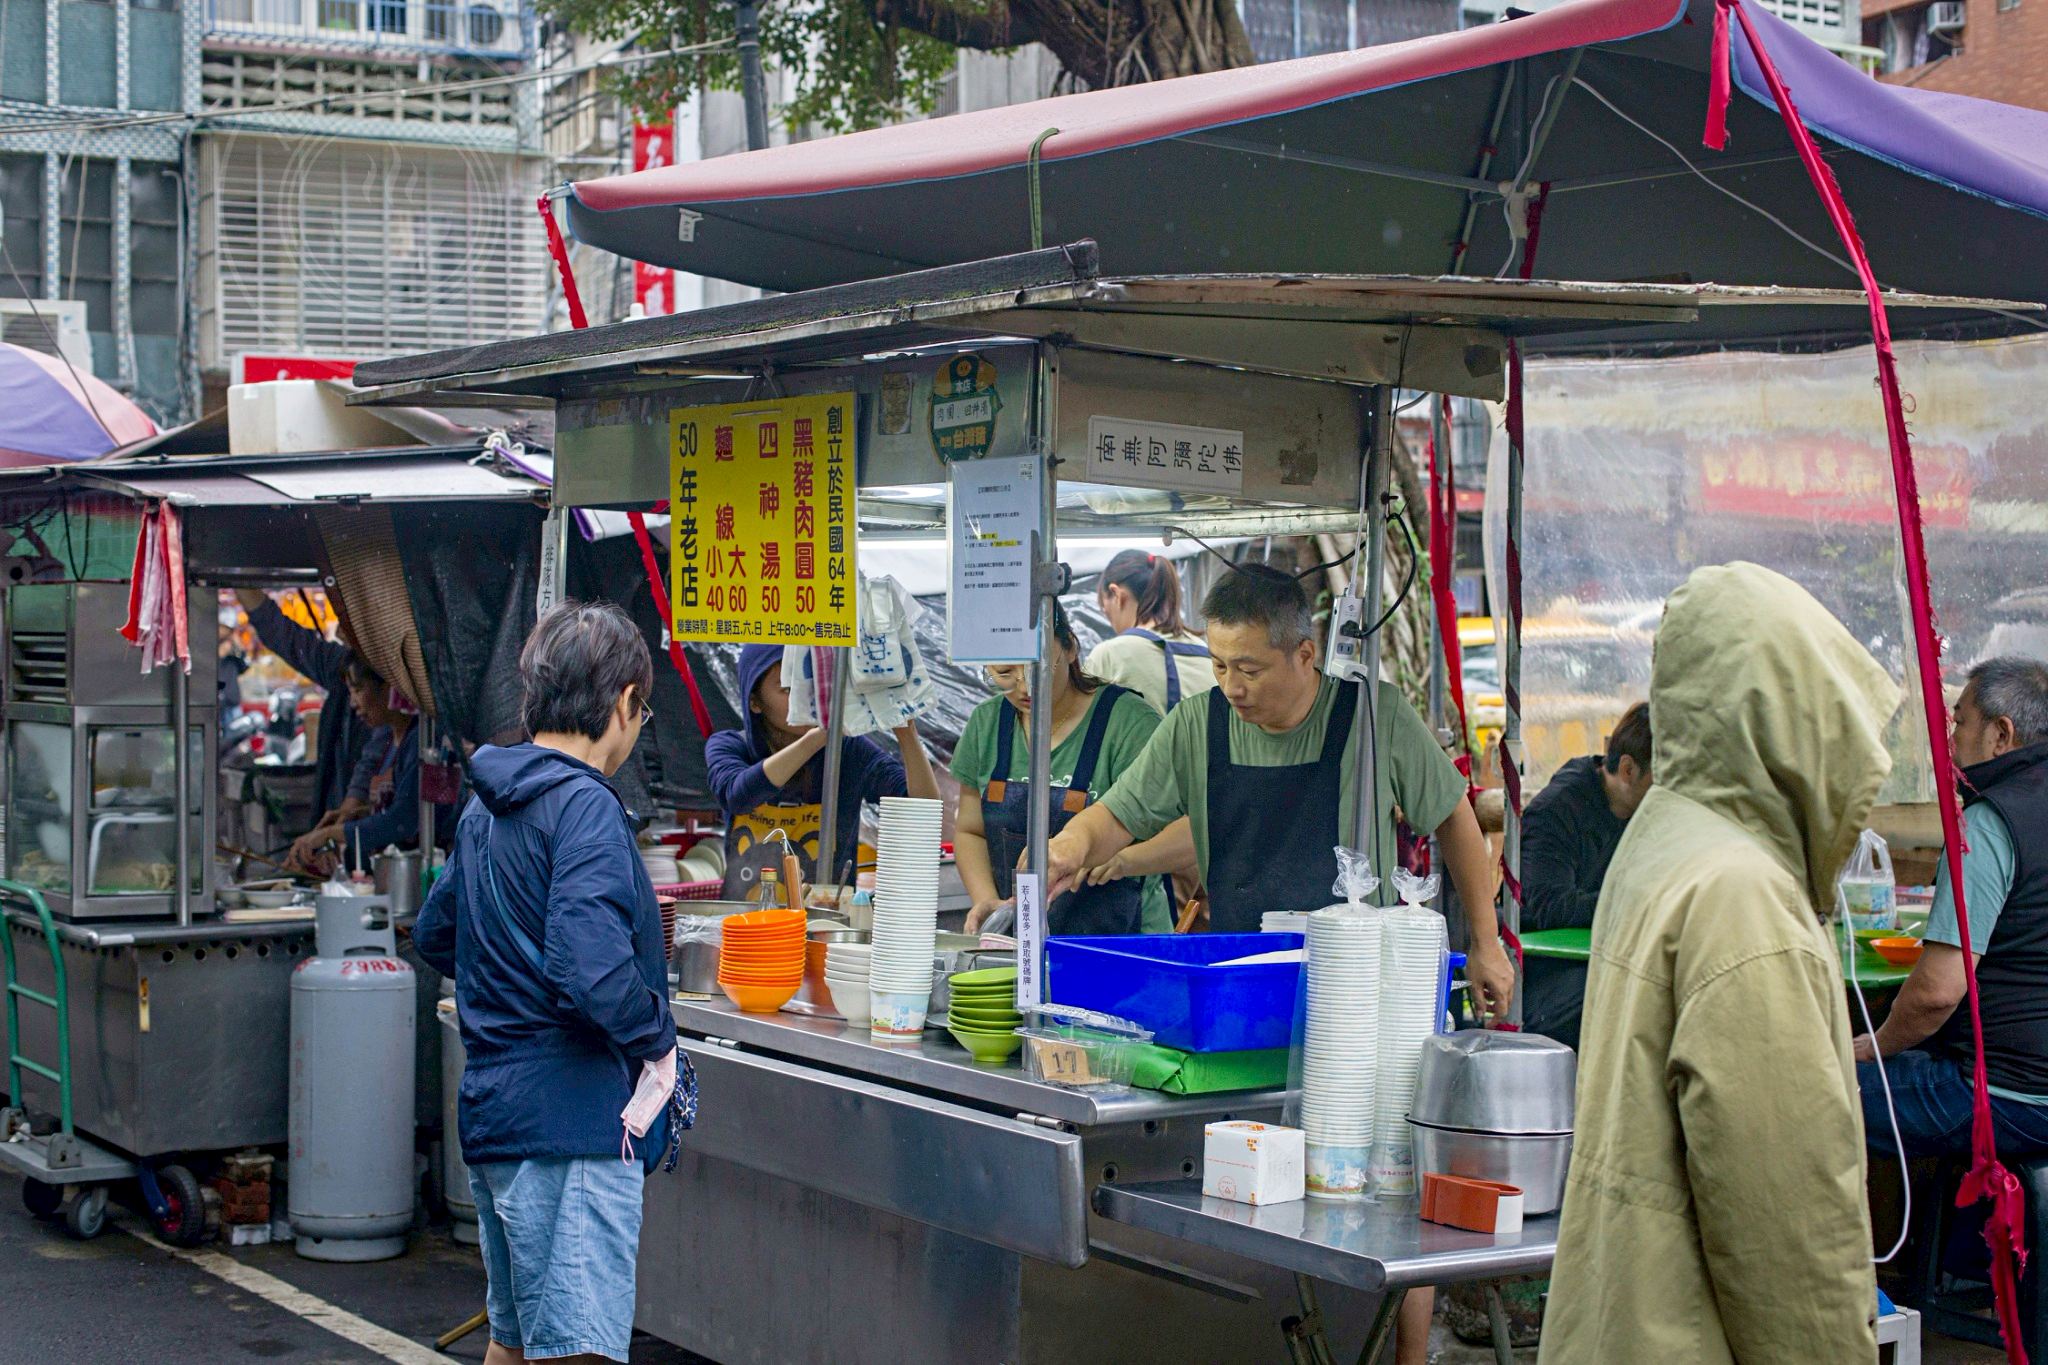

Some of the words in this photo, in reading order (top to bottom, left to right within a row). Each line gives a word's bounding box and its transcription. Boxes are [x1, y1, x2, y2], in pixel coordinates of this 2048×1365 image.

[714, 424, 735, 542] 麵線
[793, 418, 815, 580] 黑豬肉圓
[679, 421, 698, 608] 50年老店
[759, 421, 781, 581] 四神湯
[827, 405, 846, 614] 創立於民國64年
[706, 545, 724, 579] 小
[728, 544, 747, 579] 大
[706, 585, 724, 612] 40
[729, 585, 747, 612] 60
[761, 585, 780, 613] 50
[795, 585, 815, 613] 50
